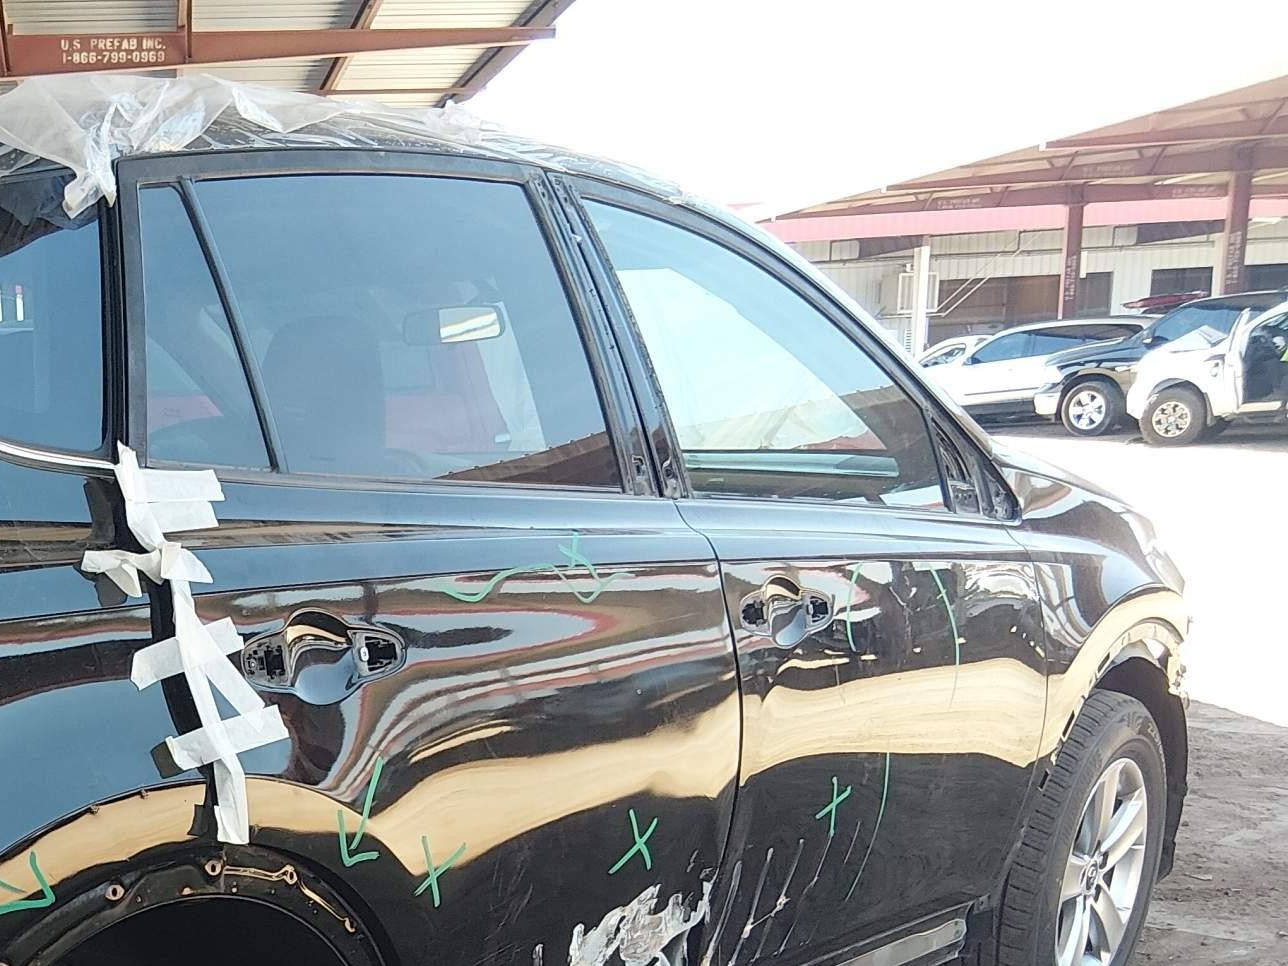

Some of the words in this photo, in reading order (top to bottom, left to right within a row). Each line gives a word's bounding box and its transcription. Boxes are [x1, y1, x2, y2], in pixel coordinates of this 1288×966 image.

[90, 37, 138, 51] PREFAB
[142, 37, 167, 50] INC.
[62, 50, 166, 65] 1-866-799-0969
